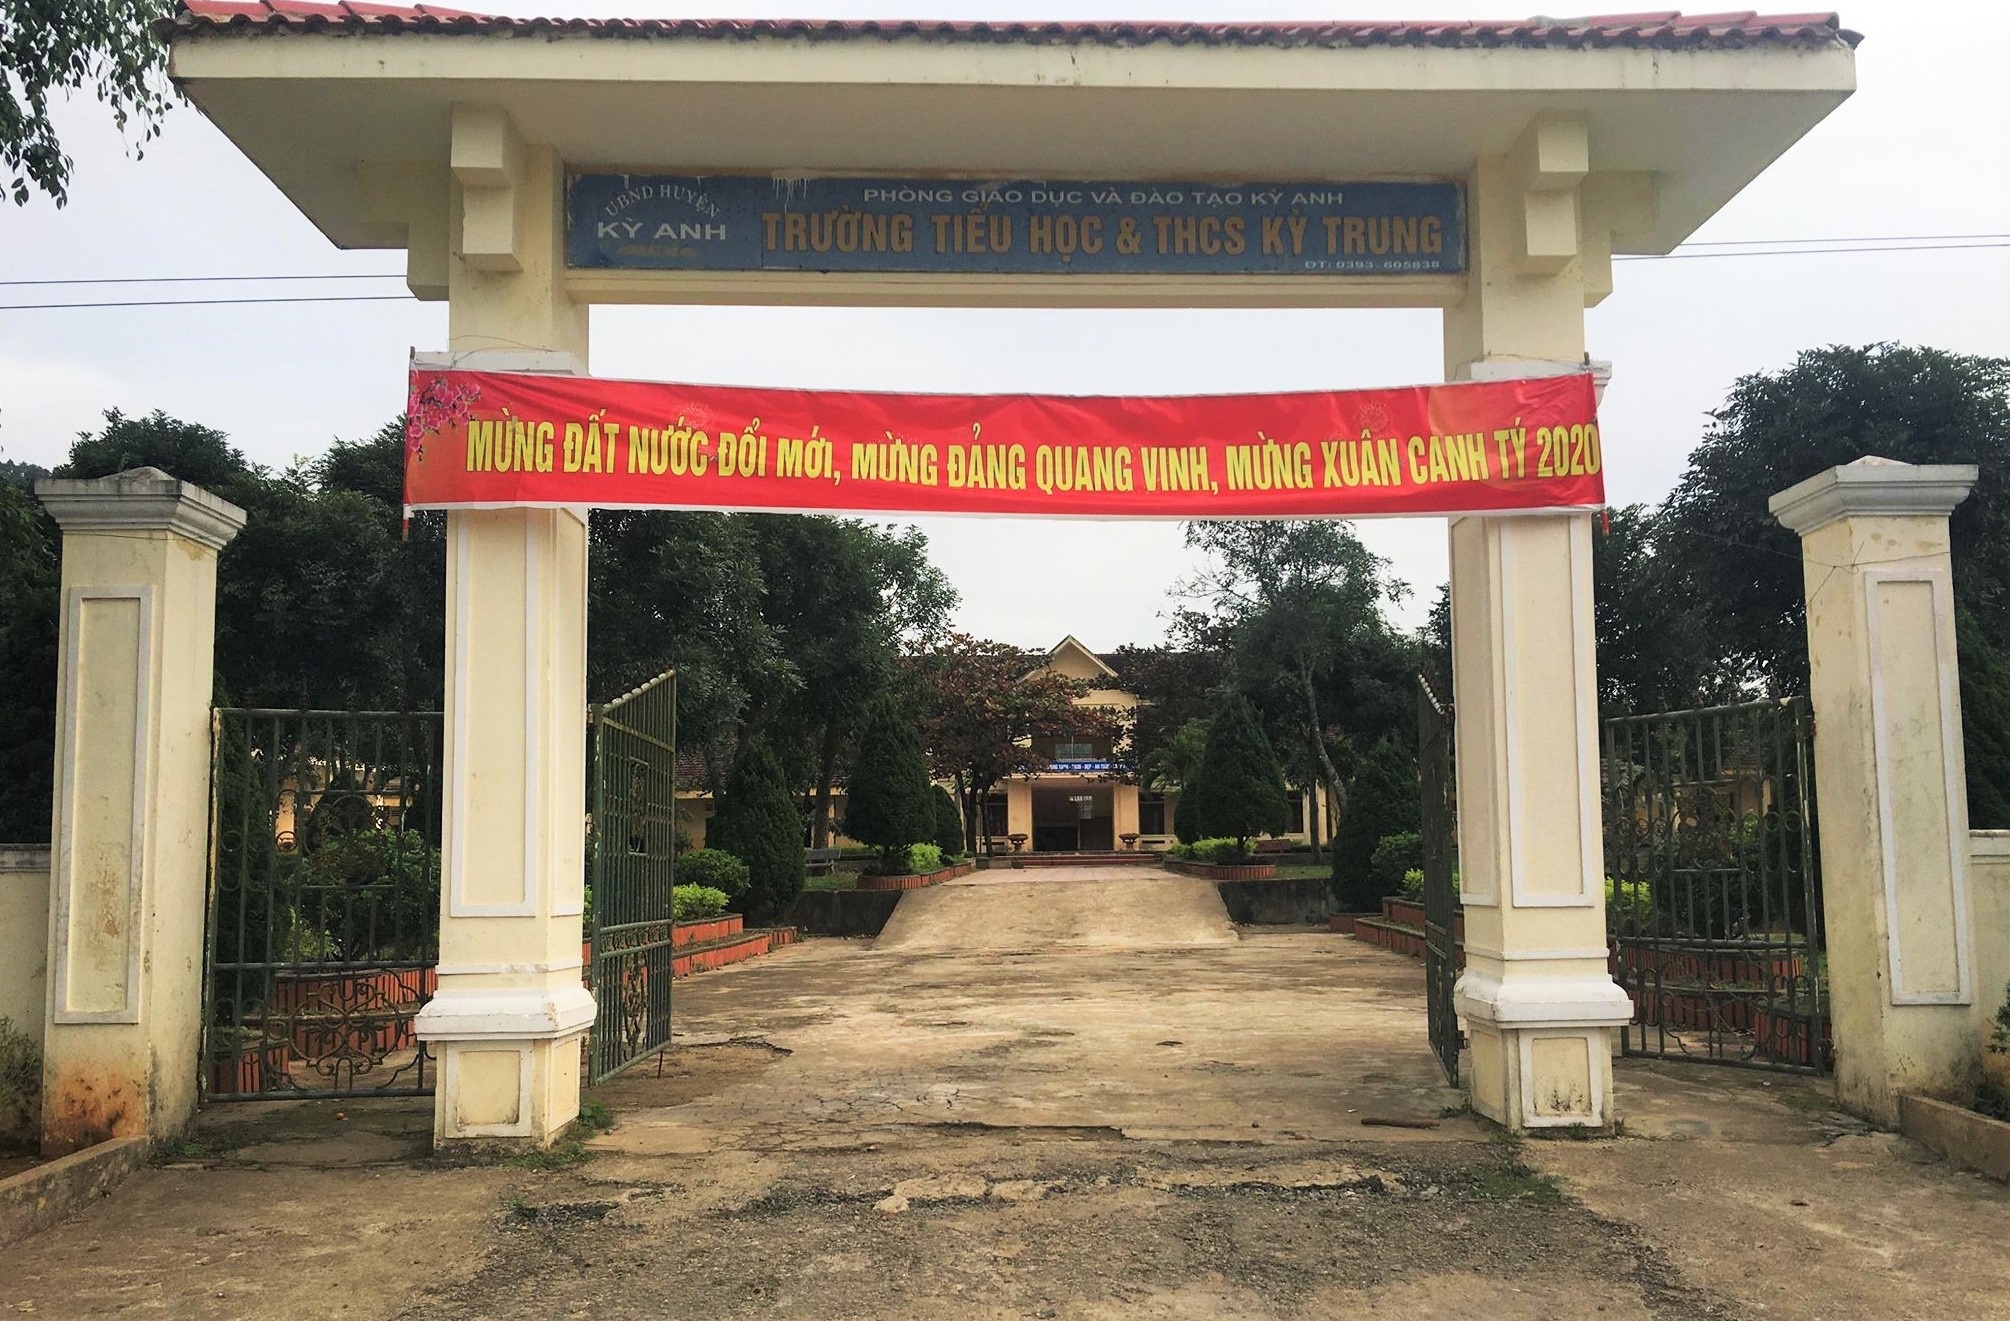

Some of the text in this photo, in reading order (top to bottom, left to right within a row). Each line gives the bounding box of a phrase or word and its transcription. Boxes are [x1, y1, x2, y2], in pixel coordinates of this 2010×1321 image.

[605, 185, 653, 216] UBND
[864, 185, 953, 203] PHÒNG
[1031, 191, 1082, 208] DỤC
[1091, 187, 1123, 205] VÀ
[1130, 187, 1184, 205] ĐÀO
[1191, 191, 1243, 208] TẠO
[1291, 192, 1343, 205] ANH
[598, 217, 726, 240] KỲ ANH
[761, 204, 913, 254] TRƯỜNG
[931, 203, 1013, 254] TIỂU
[1030, 213, 1104, 263] HỌC
[1115, 215, 1142, 256] &
[1153, 214, 1247, 256] THCS
[1321, 215, 1442, 256] TRUNG
[466, 407, 1600, 495] MỪNG ĐẤT NƯỚC ĐỔI MỚI, MỪNG ĐẢNG QUANG VINH, MỪNG XUÂN CANH TÝ 2020
